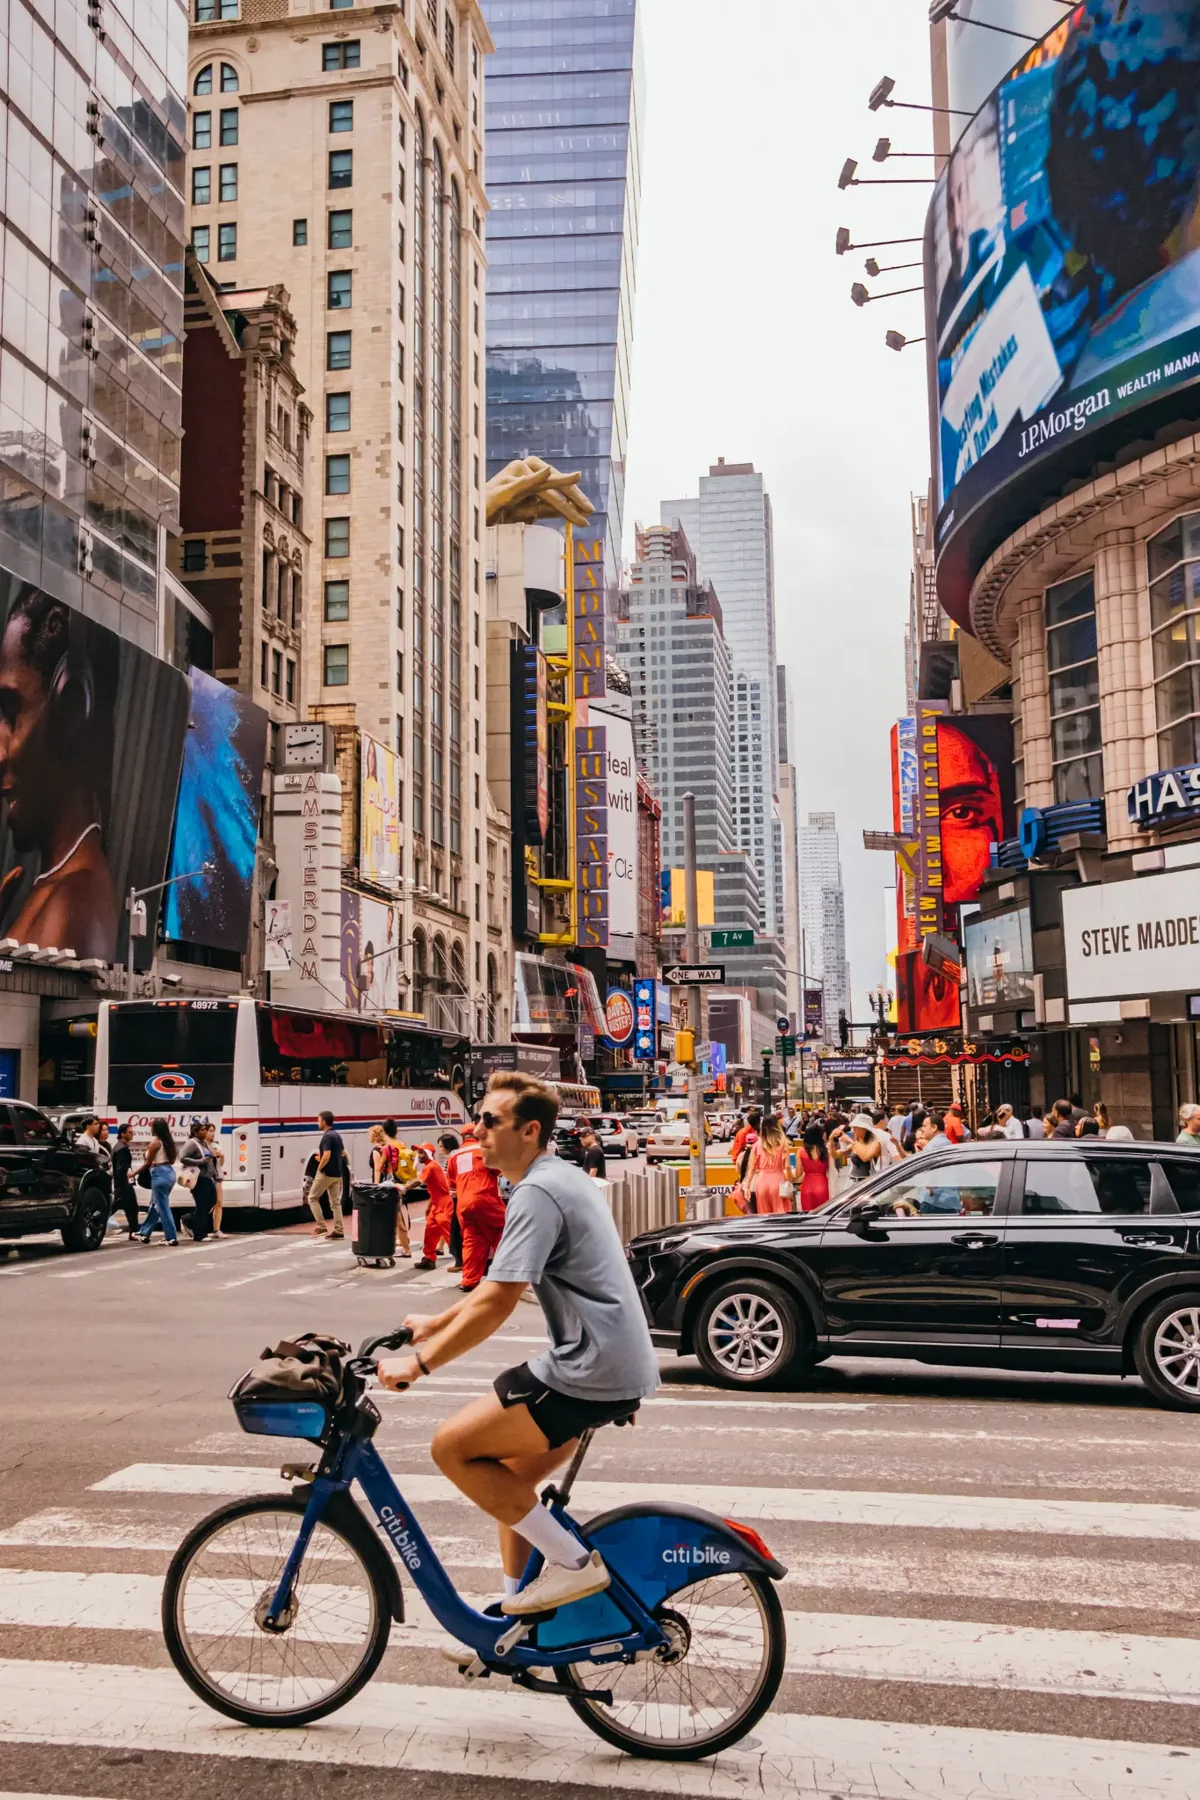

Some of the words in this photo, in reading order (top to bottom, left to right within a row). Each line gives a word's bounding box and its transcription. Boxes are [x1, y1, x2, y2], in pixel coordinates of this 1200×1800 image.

[1117, 368, 1161, 399] WEALTH
[1164, 351, 1200, 377] MANA
[577, 540, 600, 696] MADAME
[921, 708, 944, 818] VICTORY
[580, 728, 603, 946] TUSSAUDS
[284, 774, 302, 785] NEW
[300, 776, 320, 980] AMSTERDAM
[722, 933, 728, 945] 7
[1081, 925, 1131, 957] STEVE
[1137, 915, 1200, 951] MADDE
[671, 971, 689, 980] ONE
[698, 970, 717, 979] WAY
[191, 1001, 218, 1010] 48972
[607, 1003, 624, 1020] DAVE
[624, 1001, 631, 1013] &
[993, 1049, 1001, 1057] A
[1004, 1060, 1011, 1068] C
[380, 1506, 403, 1534] citi
[395, 1530, 421, 1570] bike
[662, 1545, 690, 1563] citi
[693, 1545, 730, 1564] bike
